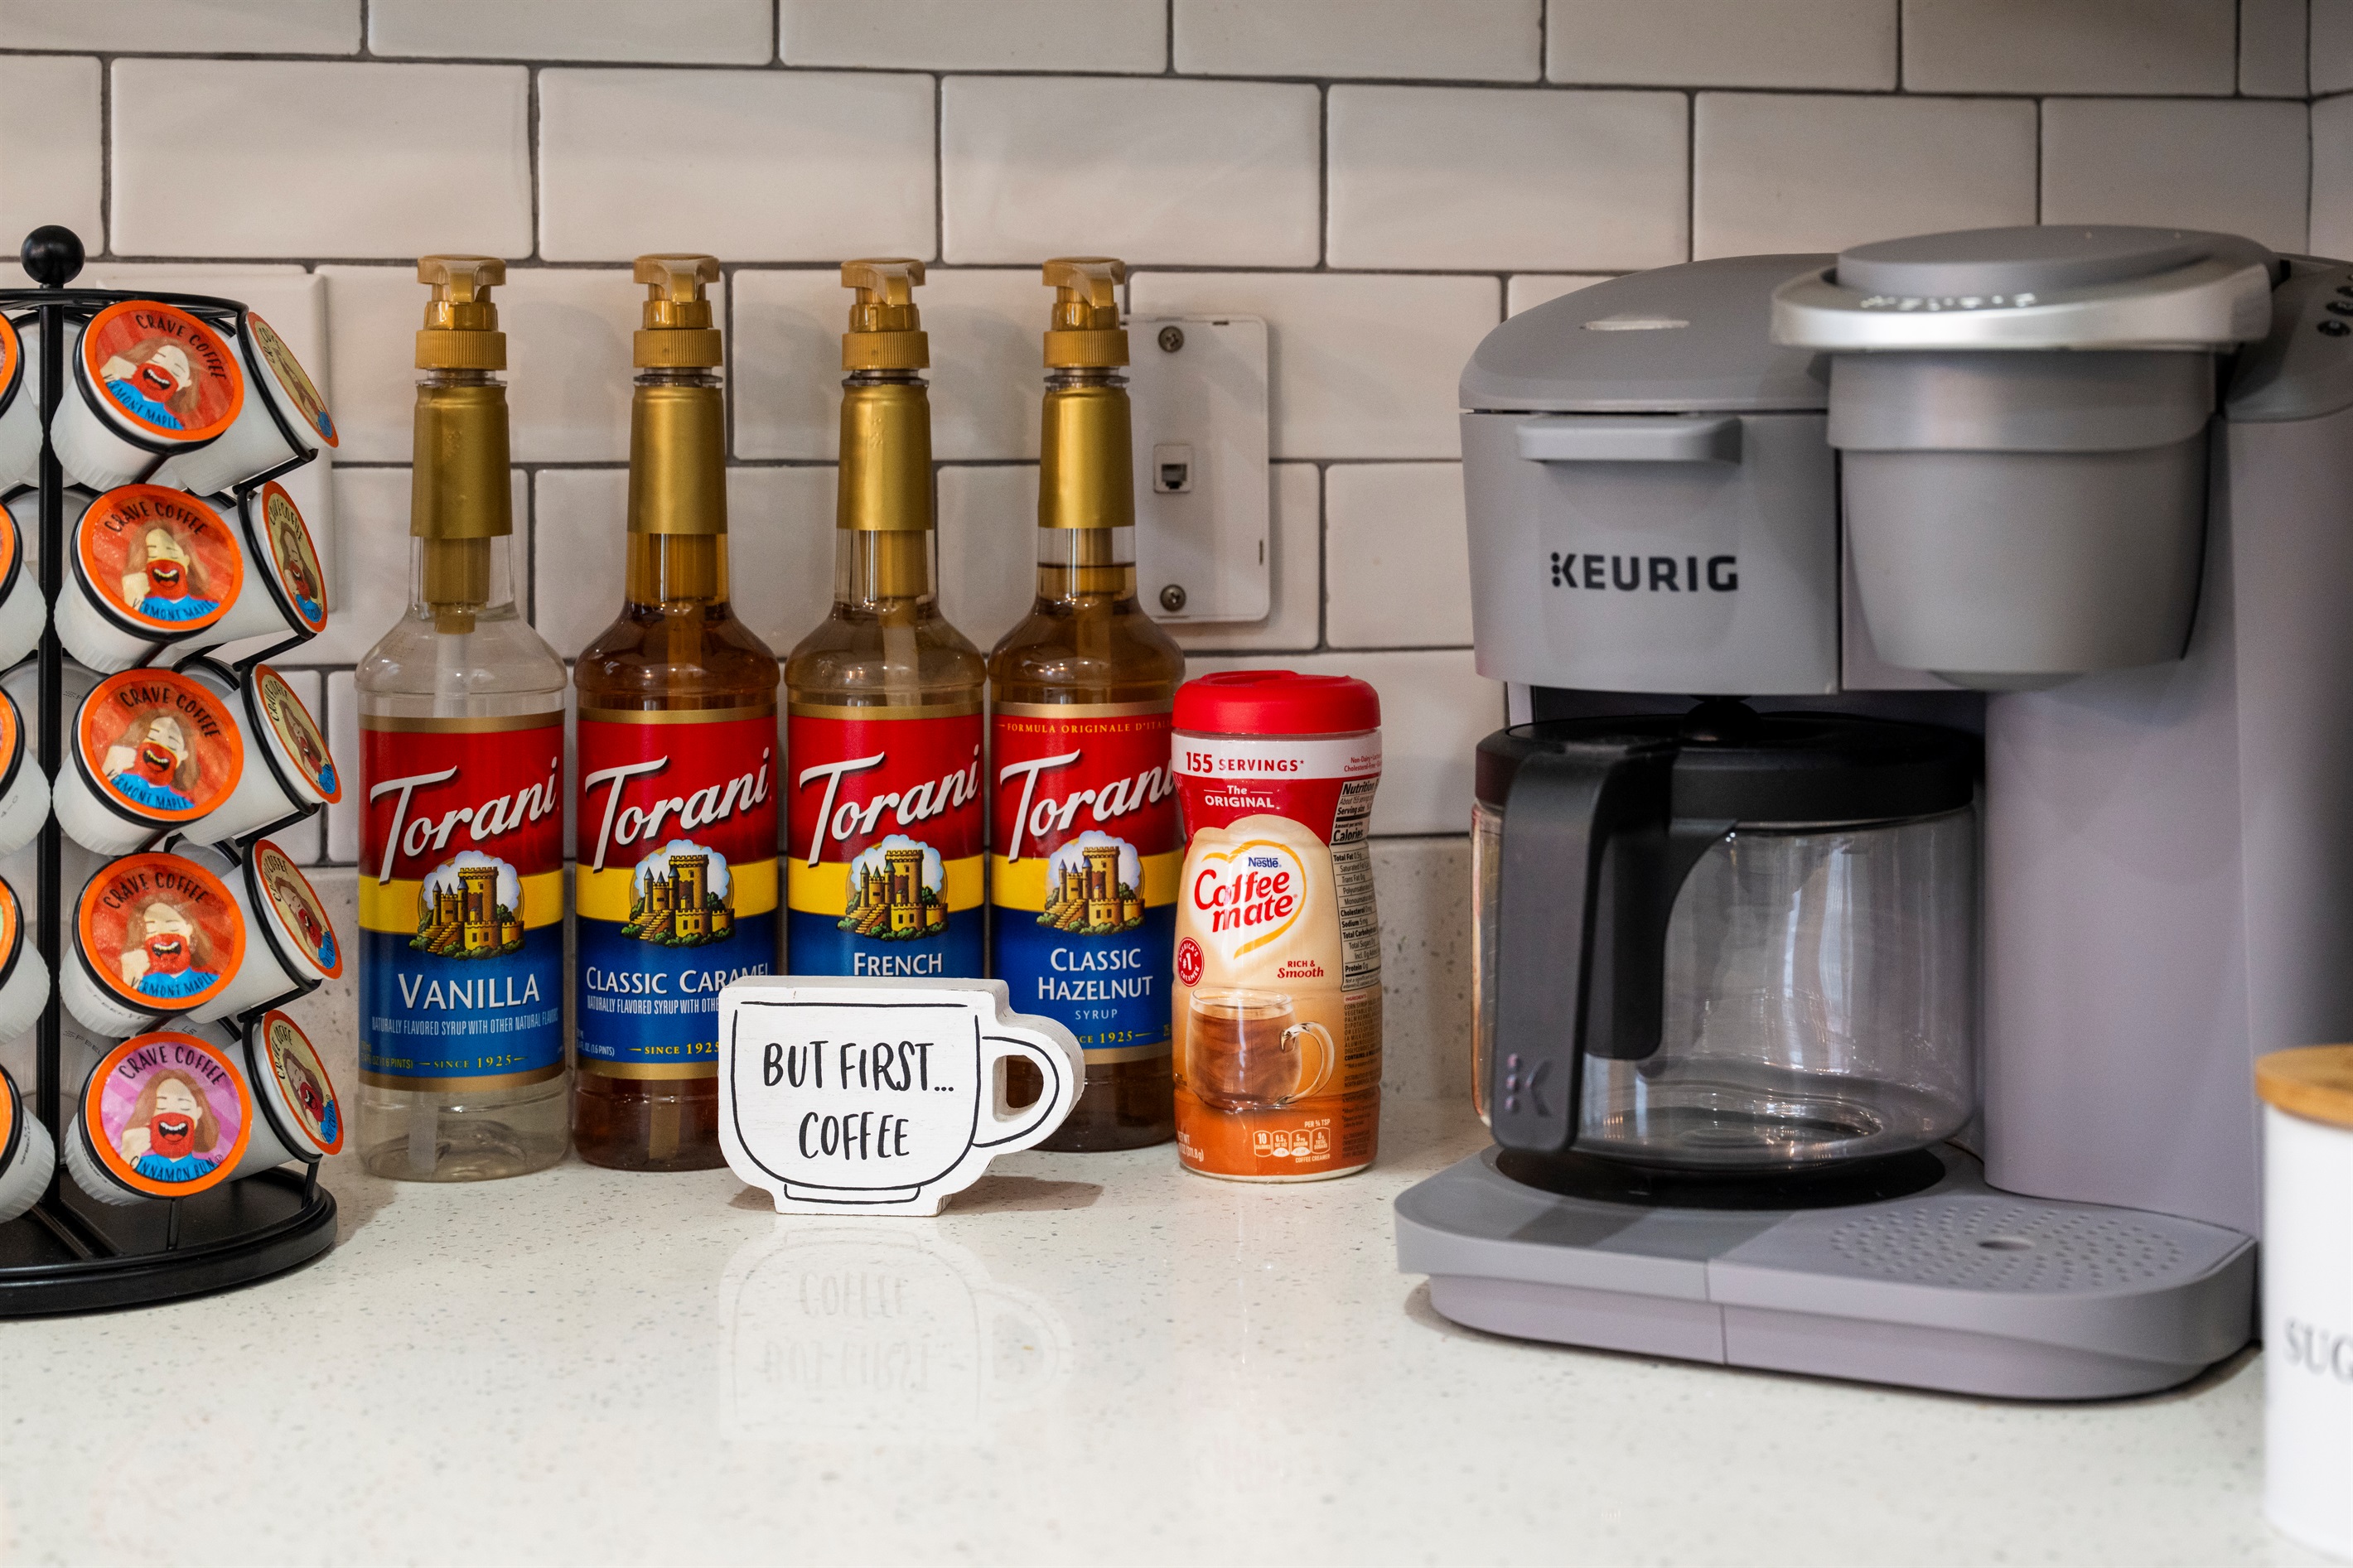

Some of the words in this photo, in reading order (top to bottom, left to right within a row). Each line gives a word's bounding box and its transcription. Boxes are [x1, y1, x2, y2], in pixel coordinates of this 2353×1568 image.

[135, 314, 186, 337] CRAVE
[189, 334, 227, 380] COFFEE
[104, 501, 150, 533] CRAVE
[154, 502, 208, 536] COFFEE
[1550, 552, 1739, 593] KEURIG
[118, 686, 171, 707] CRAVE
[176, 694, 221, 738] COFFEE
[1007, 723, 1056, 733] FORMULA
[1061, 723, 1130, 734] ORIGINALE
[1186, 751, 1213, 774] 155
[1226, 785, 1247, 795] The
[1342, 779, 1375, 795] Nutrition
[585, 746, 771, 874] Torani
[799, 744, 980, 867] Torani
[1205, 795, 1275, 808] ORIGINAL
[370, 755, 558, 886] Torani
[1333, 827, 1363, 842] Calories
[103, 873, 149, 909] CRAVE
[154, 871, 210, 904] COFFEE
[1194, 869, 1290, 910] Coffee
[1212, 895, 1293, 933] mate
[853, 953, 943, 977] FRENCH
[1050, 948, 1142, 972] CLASSIC
[131, 976, 180, 996] VERMONT
[183, 972, 214, 994] MAPLE
[586, 966, 668, 994] CLASSIC
[1277, 967, 1324, 978] Smooth
[398, 973, 540, 1011] VANILLA
[1038, 976, 1153, 1001] HAZELNUT
[587, 995, 616, 1013] NATURALLY
[617, 998, 652, 1015] FLAVORED
[655, 999, 679, 1015] SYRUP
[679, 998, 699, 1014] WITH
[702, 996, 719, 1013] OTHE
[1075, 1008, 1118, 1020] SYRUP
[372, 1016, 403, 1034] NATURALLY
[403, 1020, 439, 1035] FLAVORED
[442, 1020, 467, 1035] SYRUP
[468, 1019, 488, 1035] WITH
[490, 1017, 513, 1034] OTHER
[515, 1012, 541, 1030] NATURAL
[1099, 1030, 1133, 1044] 1925
[434, 1059, 470, 1069] SINCE
[477, 1054, 512, 1069] 1925
[645, 1046, 680, 1054] SINCE
[118, 1045, 167, 1079] CRAVE
[174, 1045, 227, 1085] COFFEE
[763, 1040, 829, 1088] BUT
[798, 1111, 910, 1160] COFFEE
[1258, 1133, 1267, 1144] 10
[129, 1155, 191, 1180] CINNAMON
[195, 1158, 215, 1176] BUN
